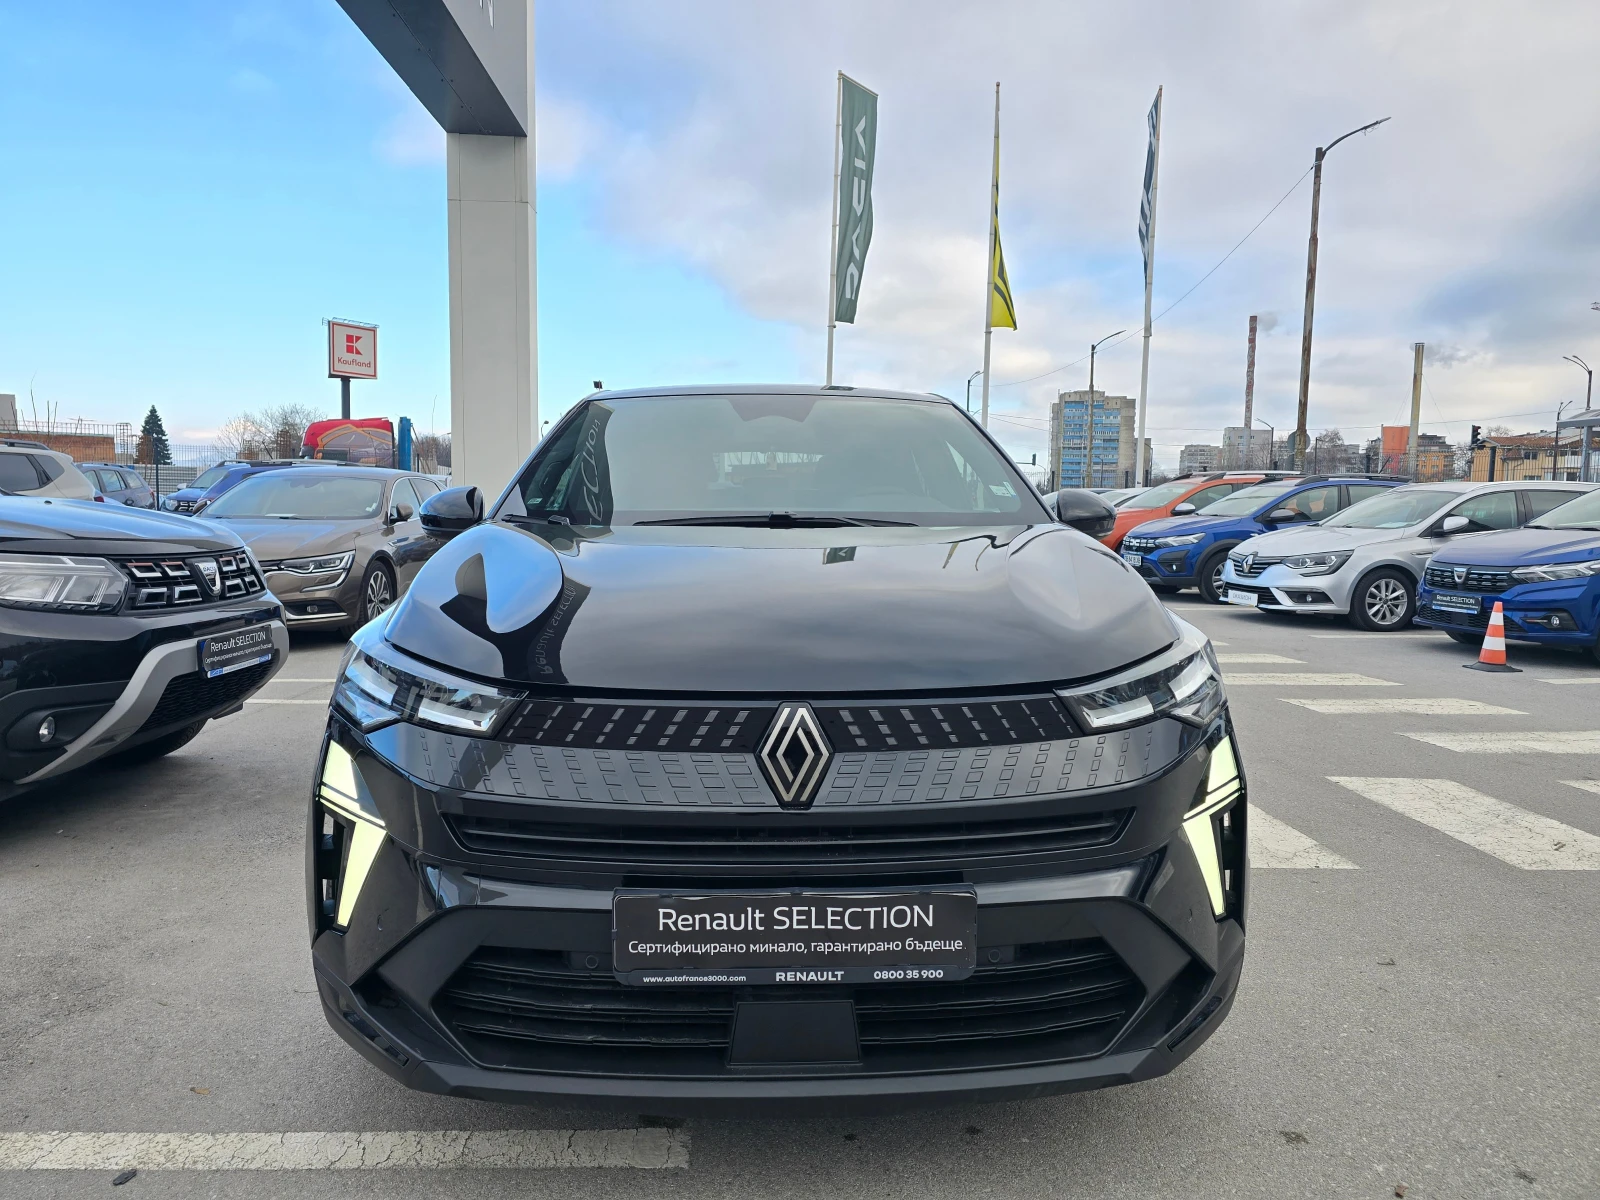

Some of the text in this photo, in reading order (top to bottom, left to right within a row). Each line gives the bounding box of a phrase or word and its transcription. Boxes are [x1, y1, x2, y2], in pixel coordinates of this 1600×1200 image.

[337, 356, 372, 368] Kaufland
[210, 637, 236, 653] Renault
[235, 631, 266, 647] SELECTION
[658, 904, 934, 931] Renault SELECTION
[628, 937, 963, 956] Сертифицирано минало, гарантирано бъдеще
[775, 970, 845, 982] RENAULT
[873, 969, 944, 980] 0800 35 900
